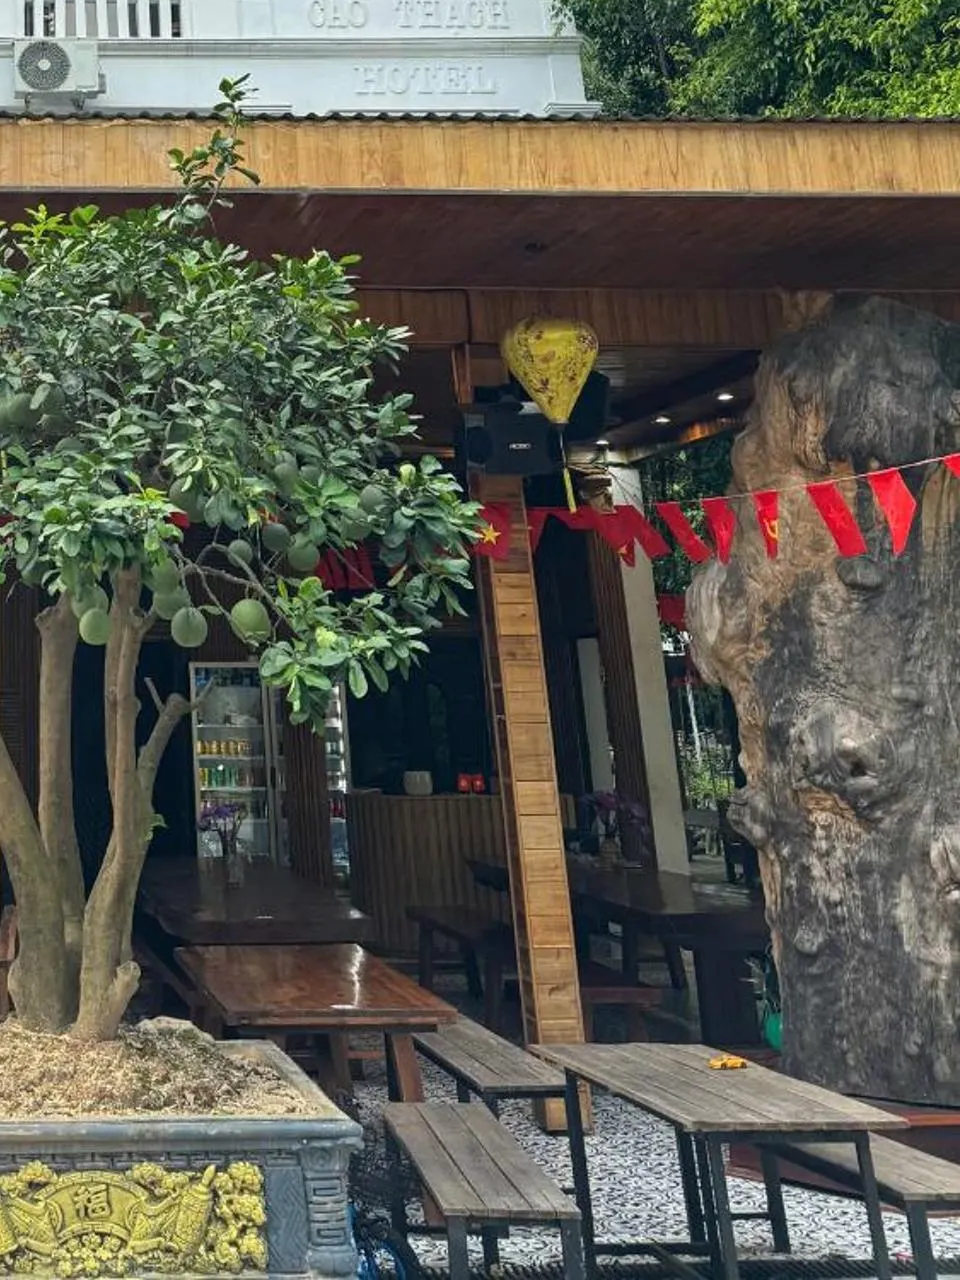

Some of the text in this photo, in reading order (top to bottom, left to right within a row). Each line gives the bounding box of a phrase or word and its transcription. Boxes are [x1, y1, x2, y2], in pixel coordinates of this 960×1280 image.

[308, 0, 368, 28] CAO
[353, 66, 498, 95] HOTEL
[73, 1184, 111, 1219] 福
